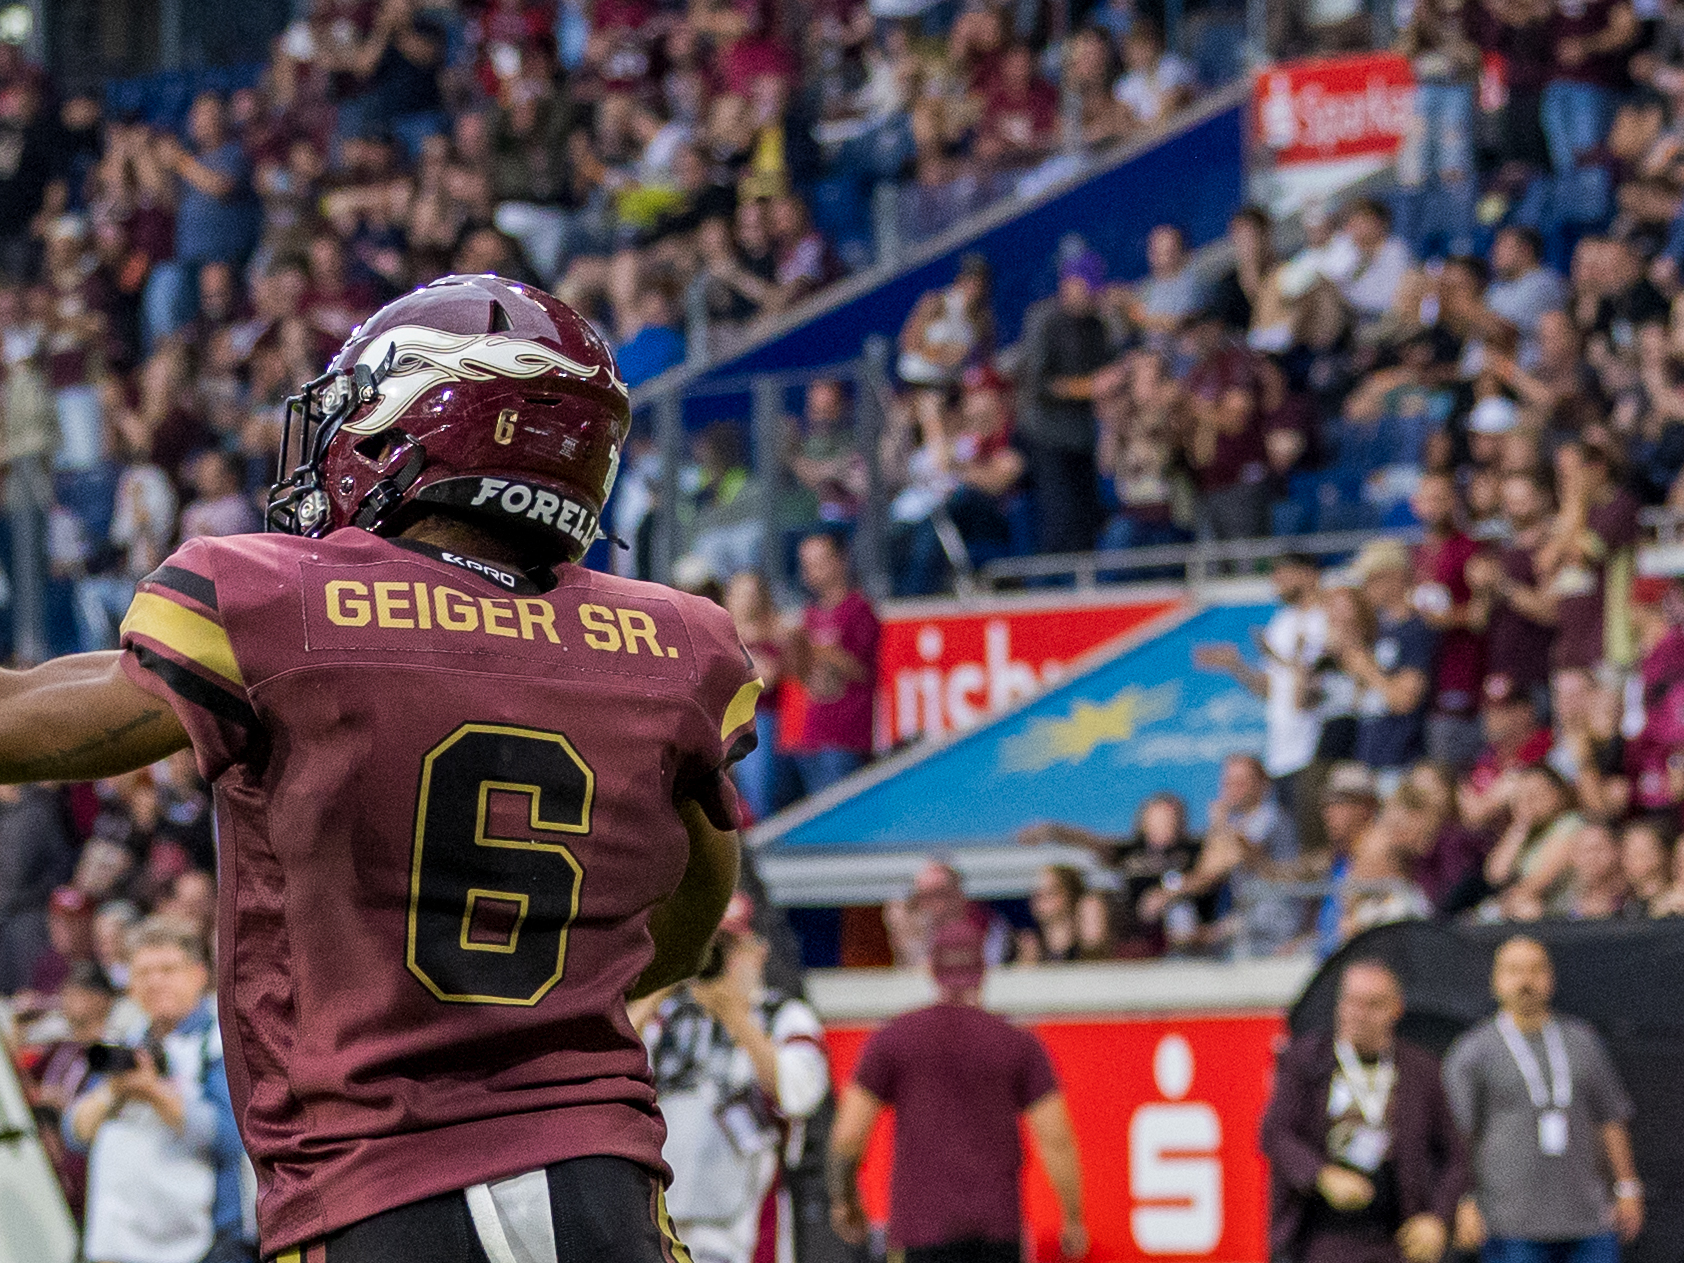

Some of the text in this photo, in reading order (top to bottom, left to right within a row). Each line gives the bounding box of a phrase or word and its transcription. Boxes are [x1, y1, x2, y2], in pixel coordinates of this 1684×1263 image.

[494, 408, 519, 446] 6
[324, 580, 680, 660] GEIGER SR.
[406, 722, 595, 1006] 6
